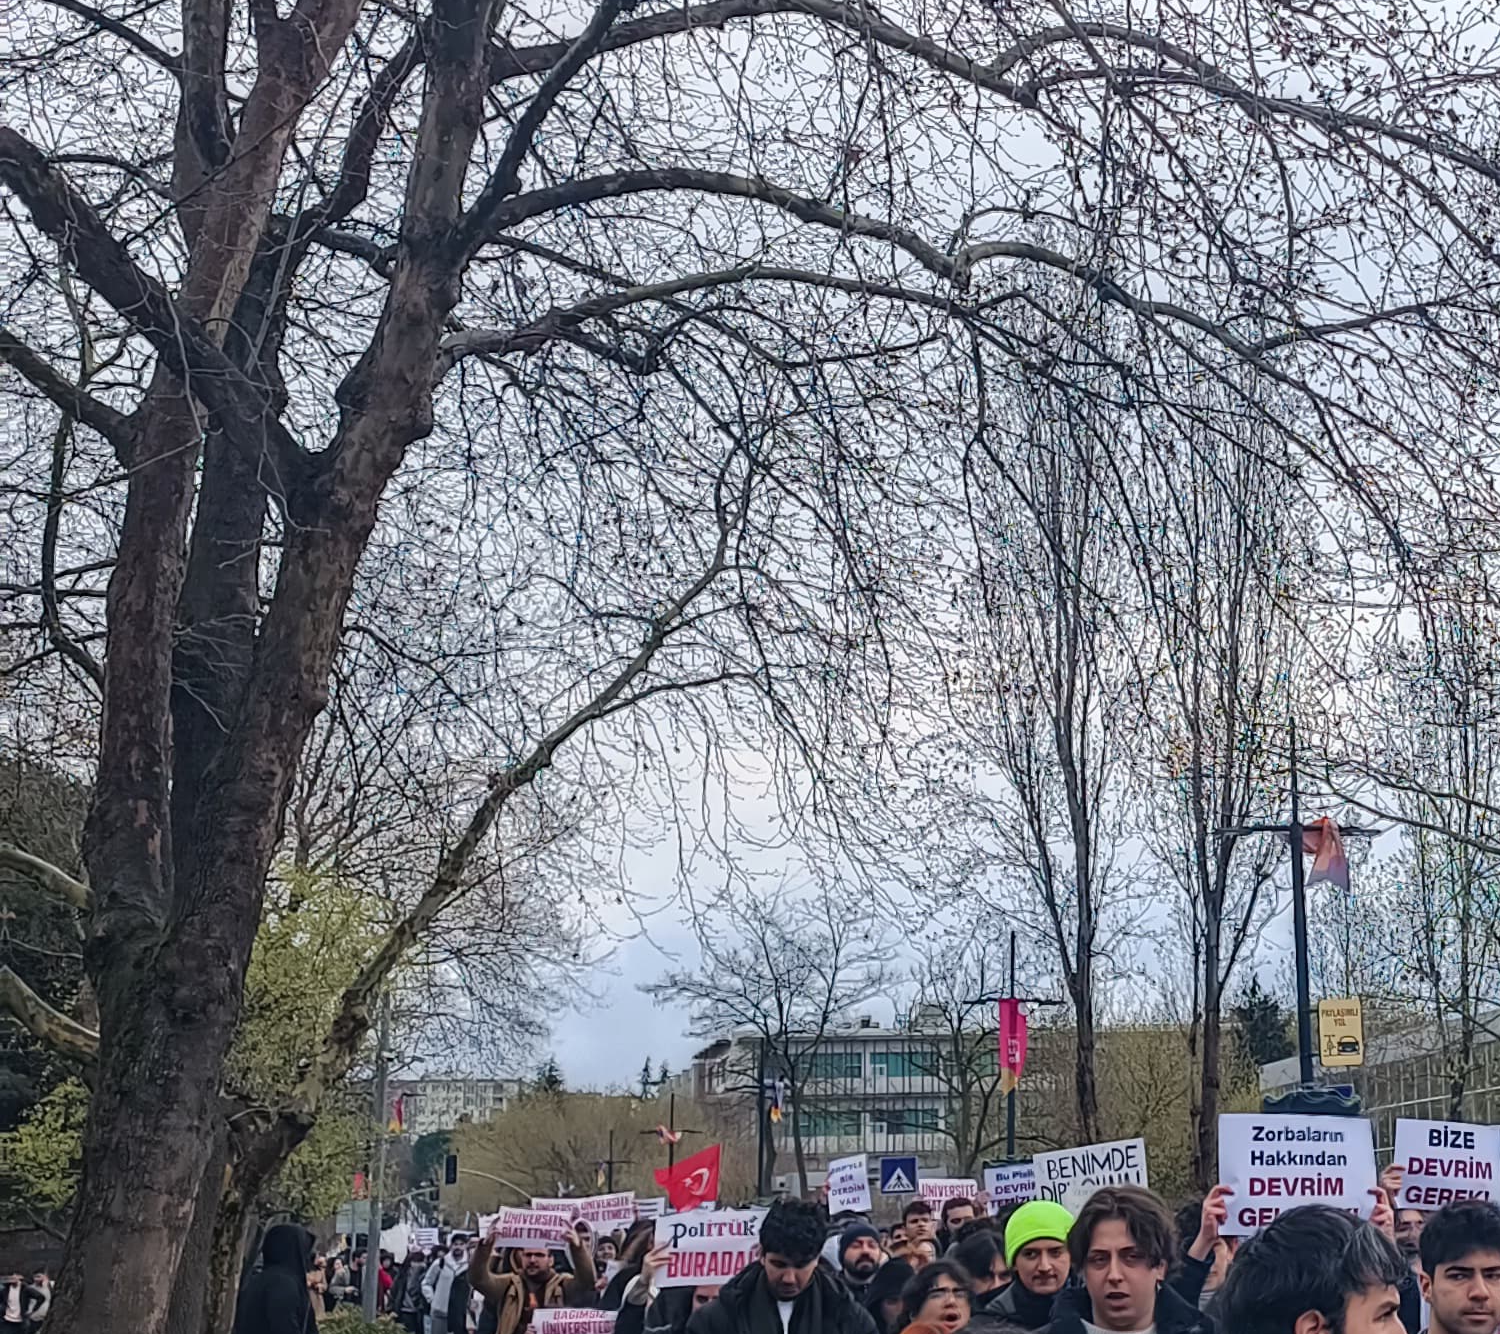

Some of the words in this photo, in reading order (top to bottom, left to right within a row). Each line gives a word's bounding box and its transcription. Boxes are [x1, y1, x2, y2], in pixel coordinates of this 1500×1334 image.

[1251, 1125, 1344, 1142] Zorbaların
[1428, 1125, 1475, 1149] BİZE
[1046, 1145, 1139, 1180] BENİMDE
[1250, 1150, 1347, 1166] Hakkından
[1407, 1156, 1493, 1180] DEVRİM
[1249, 1173, 1344, 1197] DEVRİM
